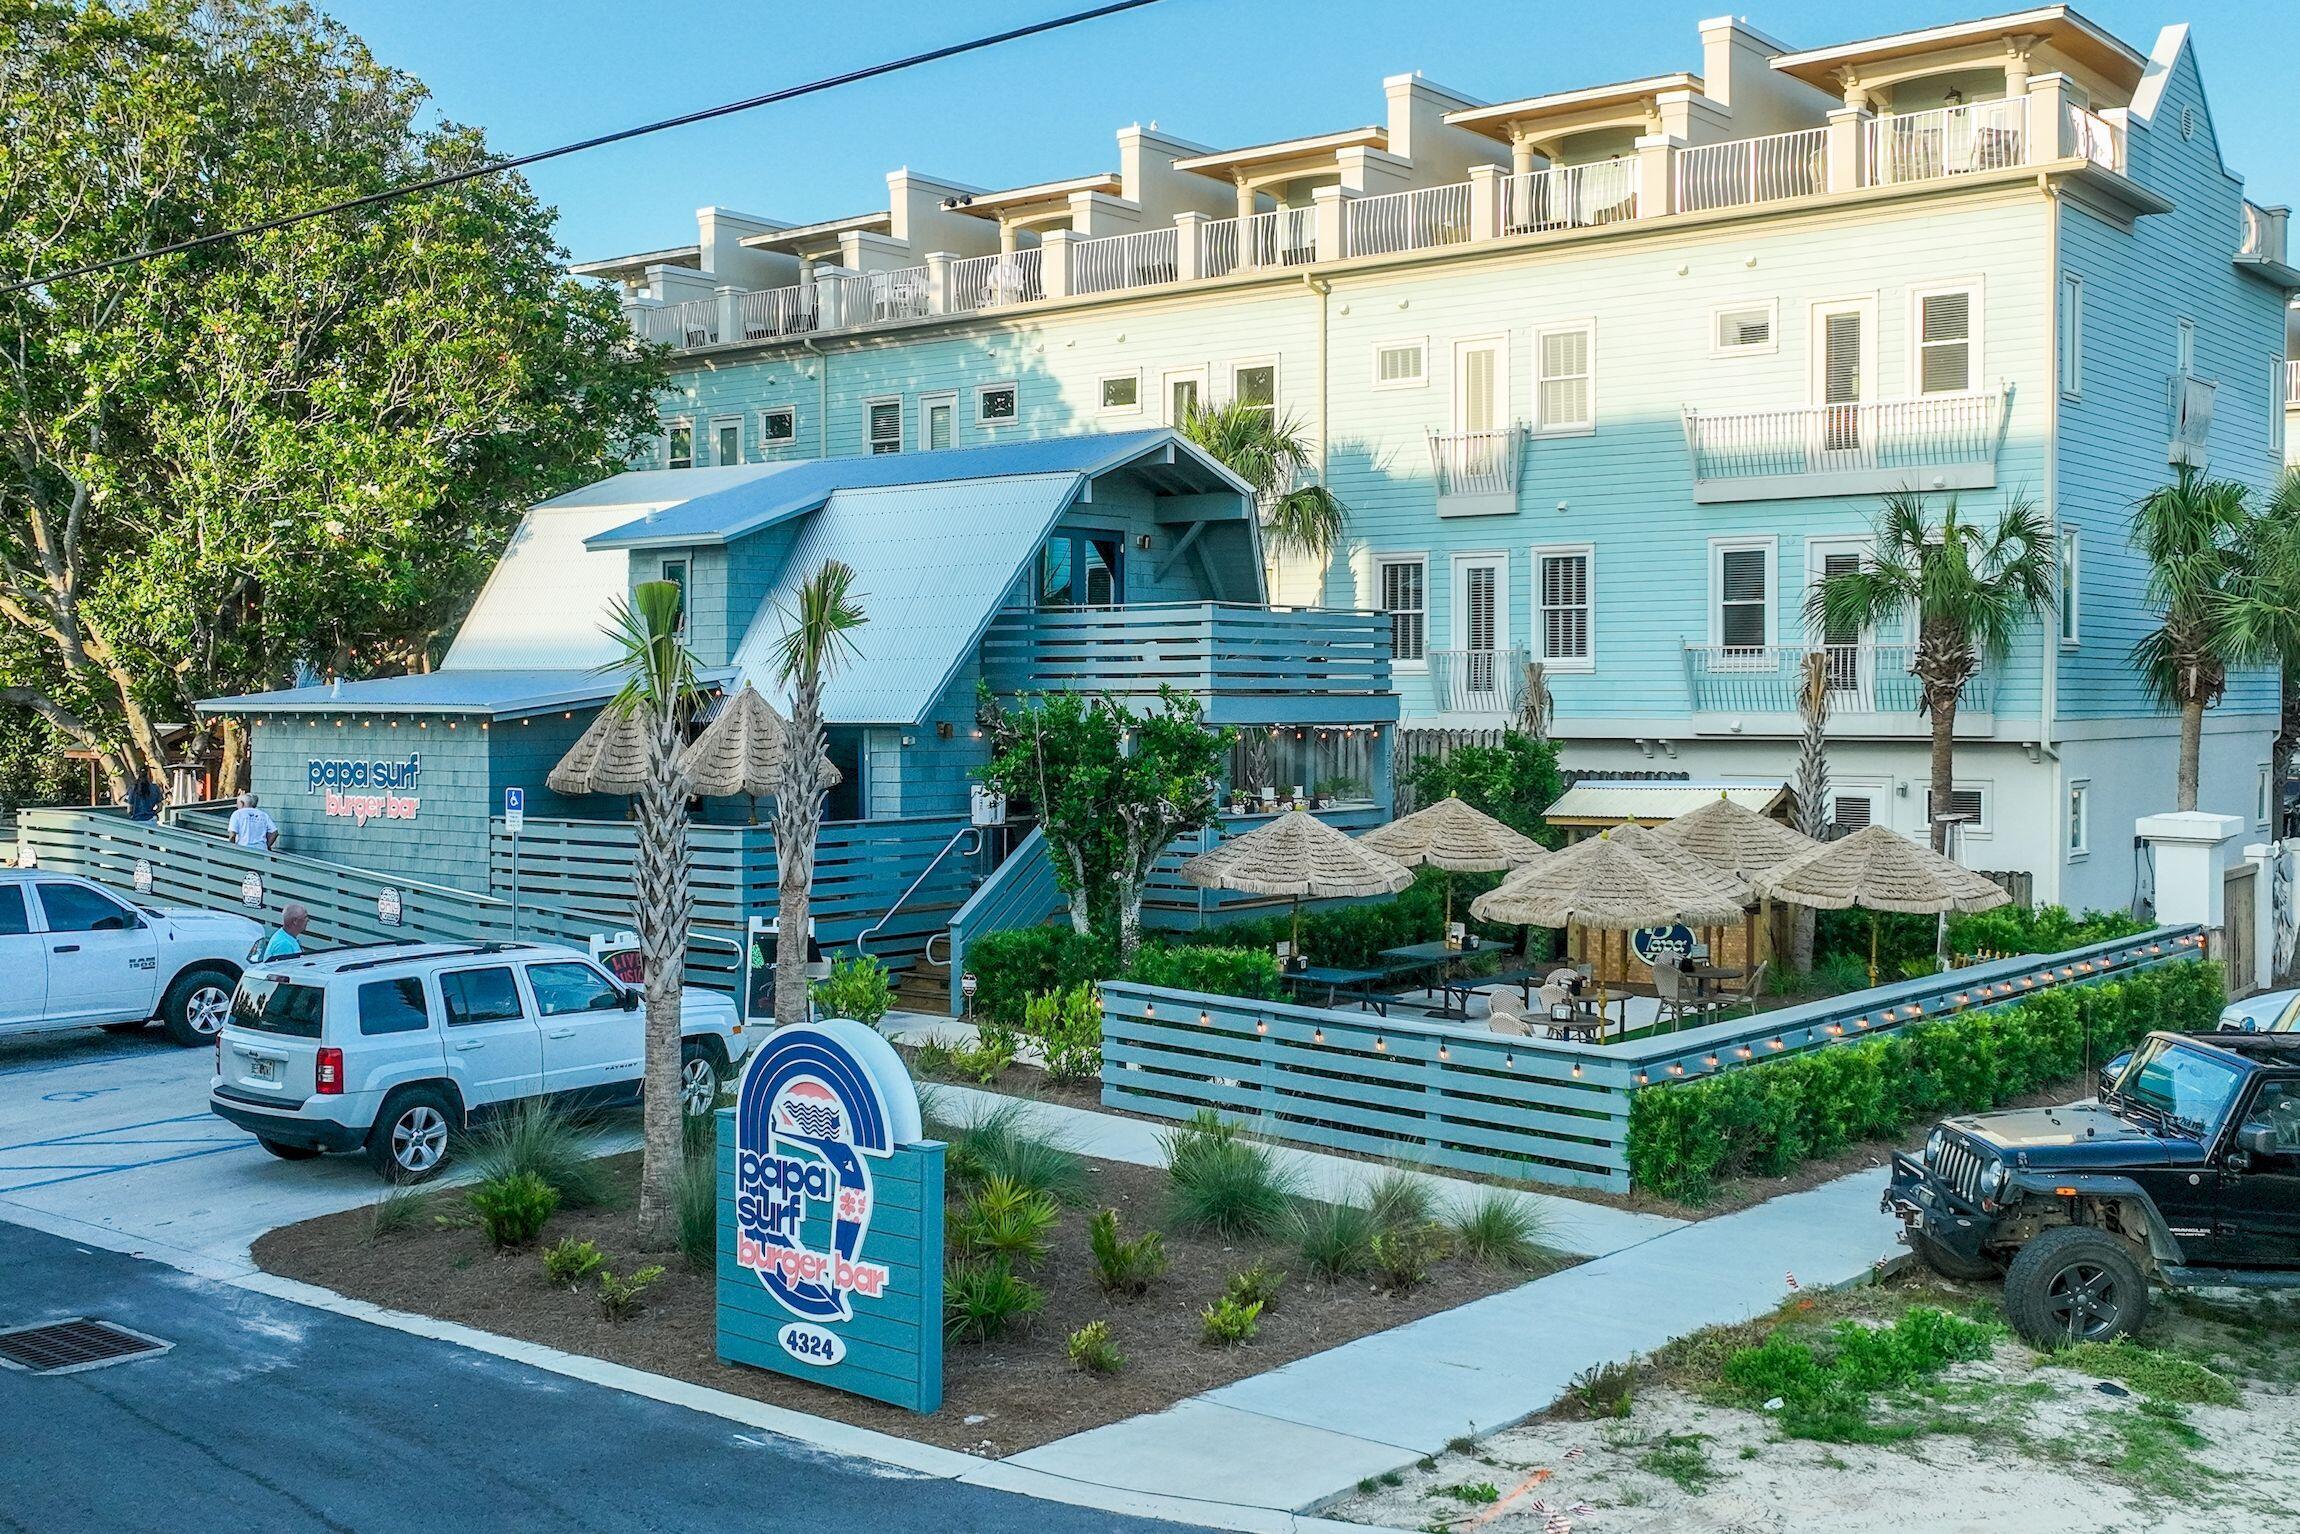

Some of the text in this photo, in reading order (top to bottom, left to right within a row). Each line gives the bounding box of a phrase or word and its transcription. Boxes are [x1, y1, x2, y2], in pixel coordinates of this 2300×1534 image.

[308, 752, 420, 794] papa surf
[325, 788, 420, 827] burger bar
[738, 1151, 828, 1201] papa
[737, 1194, 801, 1236] surf
[738, 1231, 885, 1294] burger bar
[786, 1328, 834, 1361] 4324
